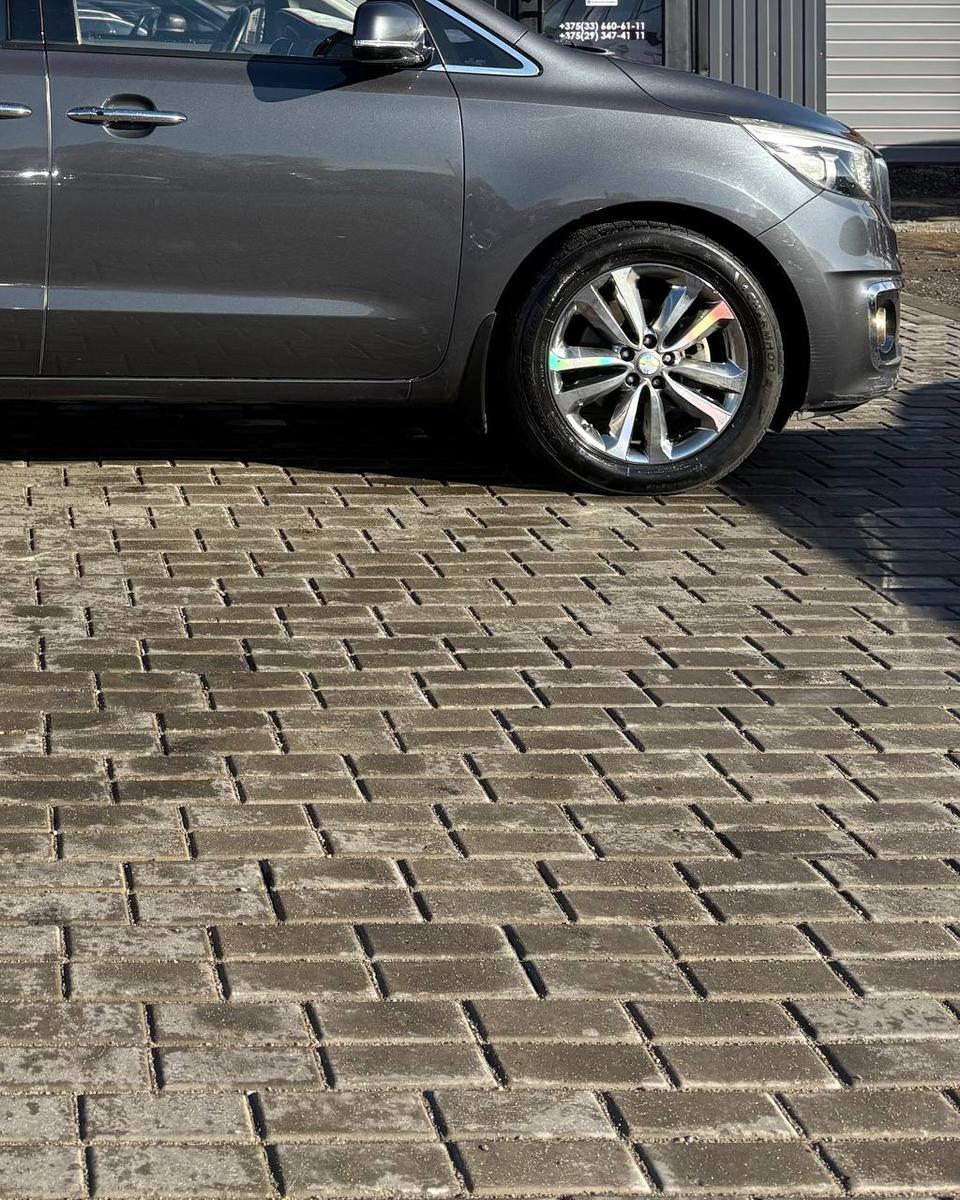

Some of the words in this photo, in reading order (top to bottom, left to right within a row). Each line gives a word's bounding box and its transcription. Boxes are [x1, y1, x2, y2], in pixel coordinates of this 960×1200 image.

[559, 21, 599, 32] +375(33)
[600, 21, 645, 31] 660-61-11
[559, 31, 599, 42] +375(29)
